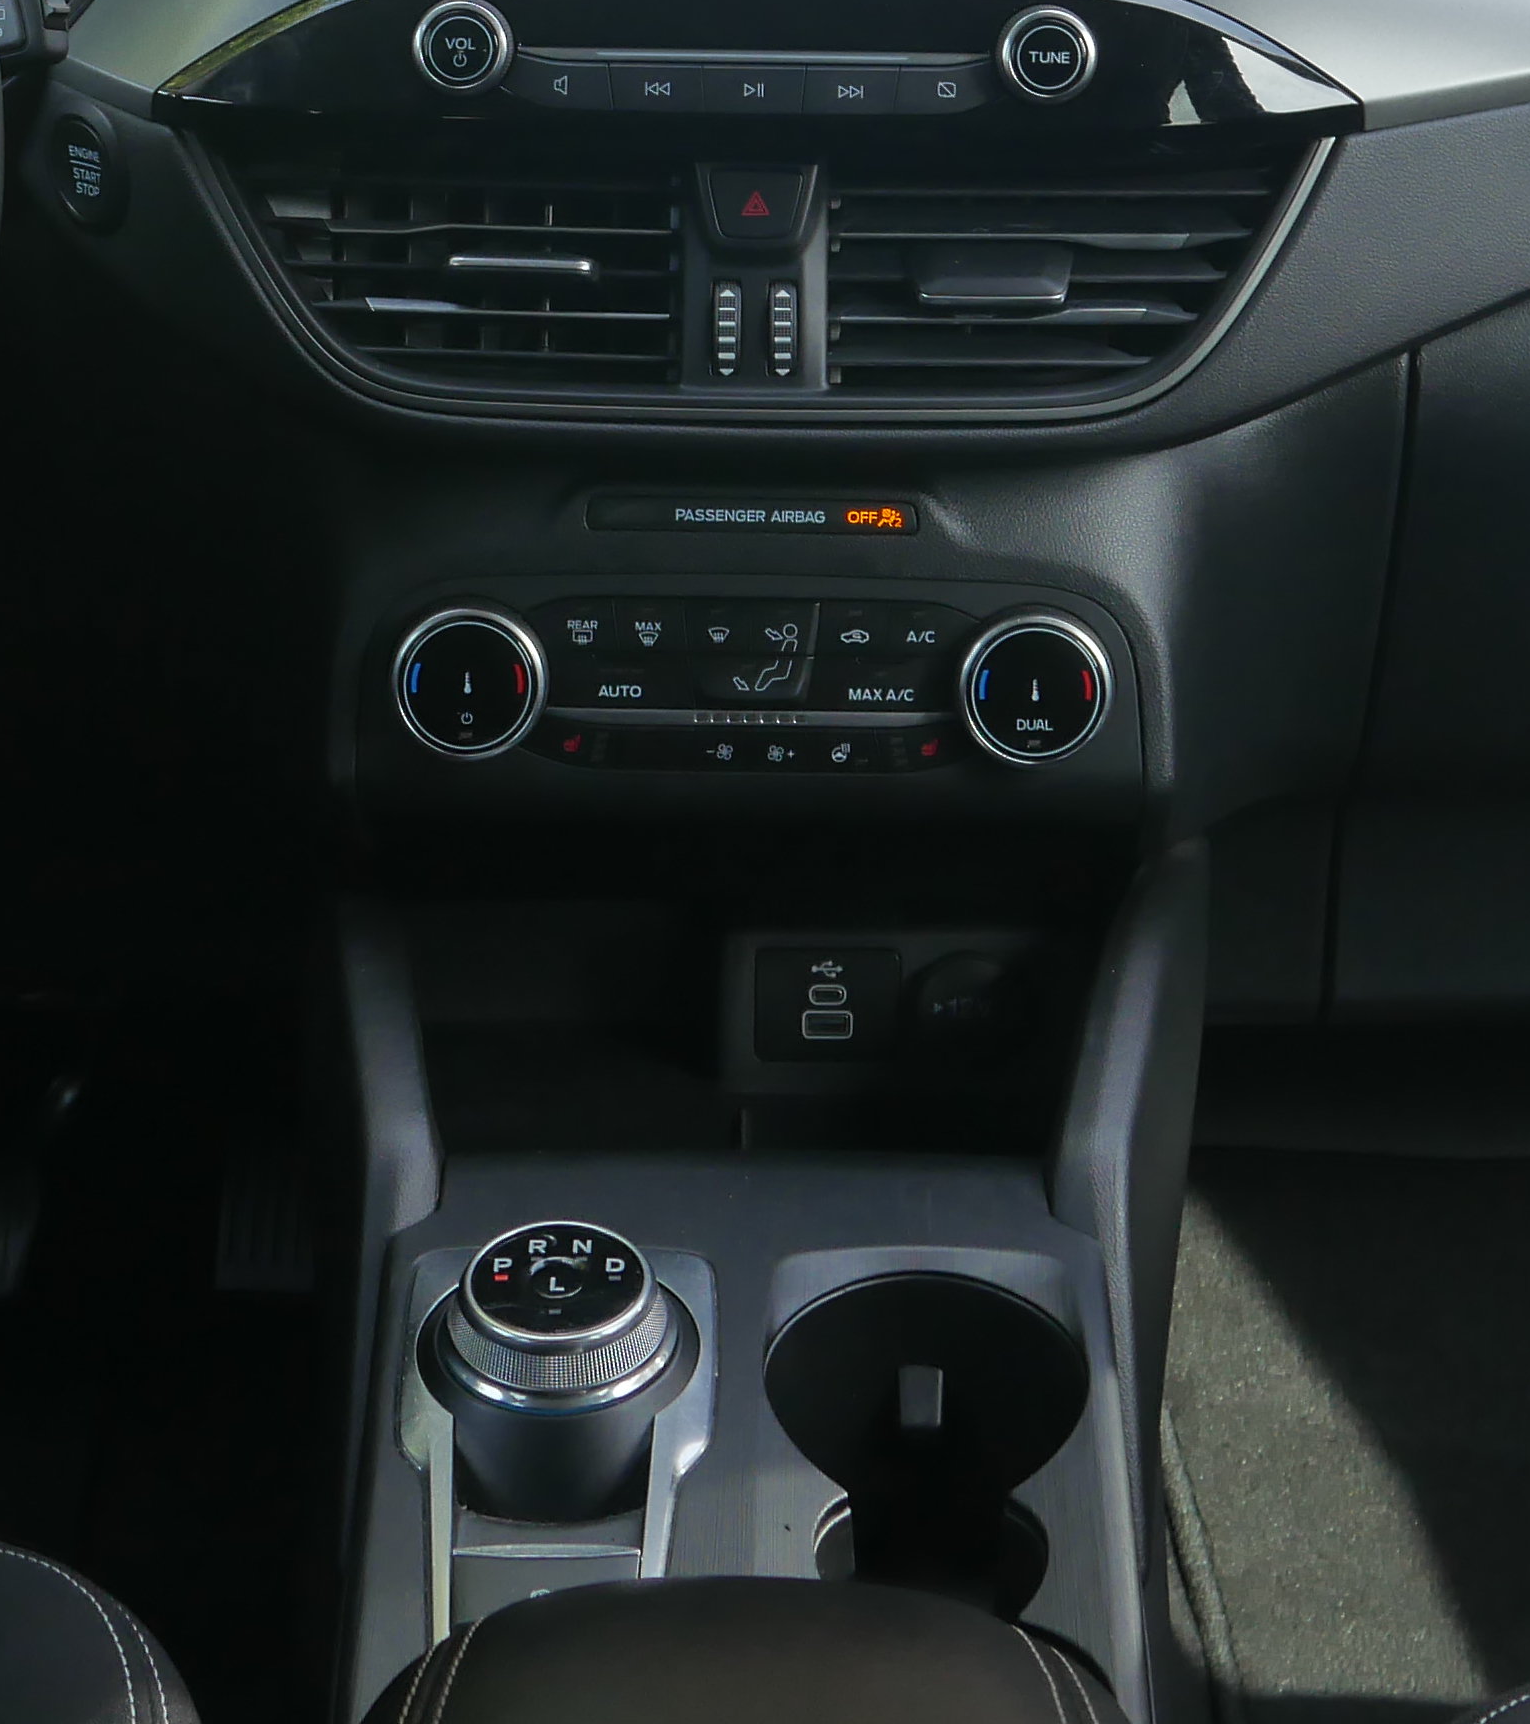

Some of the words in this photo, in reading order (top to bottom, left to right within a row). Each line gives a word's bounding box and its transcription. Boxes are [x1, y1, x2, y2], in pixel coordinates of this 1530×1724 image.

[445, 37, 476, 51] VOL
[1029, 50, 1071, 64] TUNE
[68, 144, 101, 162] ENGINE
[73, 167, 101, 185] START
[76, 182, 100, 197] STOP
[675, 508, 766, 523] PASSENGER
[771, 509, 826, 523] AIRBAG
[847, 510, 878, 524] OFF
[567, 620, 598, 630] REAR
[634, 621, 662, 631] MAX
[906, 630, 936, 643] A/C
[598, 685, 642, 697] AUTO
[848, 688, 883, 701] MAX
[886, 688, 914, 701] A/C
[1016, 718, 1054, 731] DUAL
[528, 1239, 547, 1254] R
[572, 1239, 592, 1254] N
[493, 1257, 513, 1273] P
[605, 1257, 626, 1273] D
[549, 1276, 565, 1292] L
